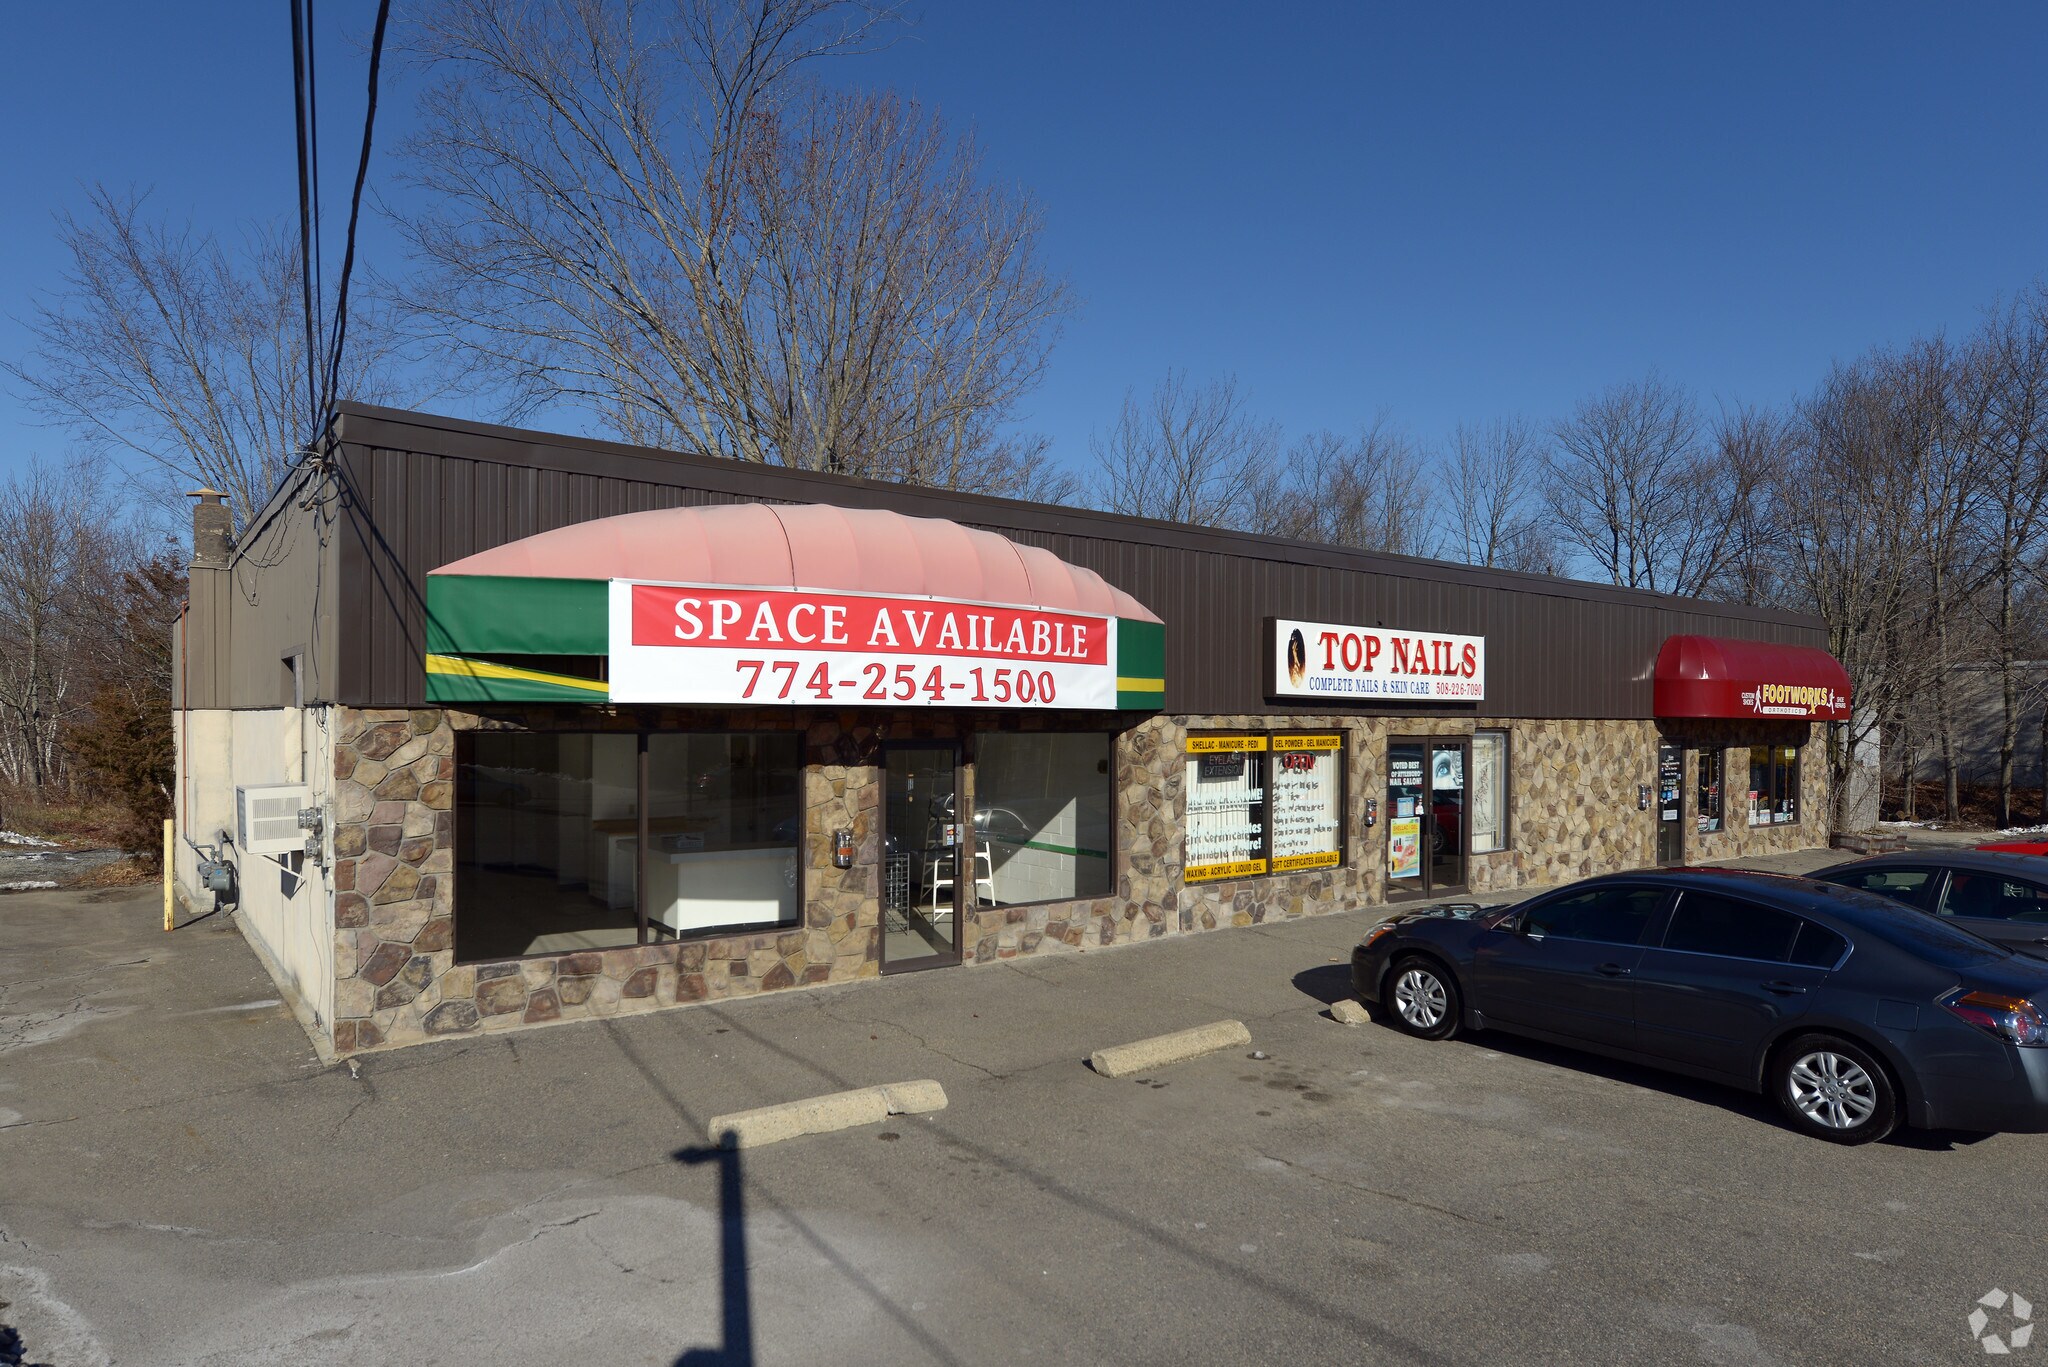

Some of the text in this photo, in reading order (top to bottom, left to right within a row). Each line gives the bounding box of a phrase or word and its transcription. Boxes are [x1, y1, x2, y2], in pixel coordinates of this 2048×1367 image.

[674, 598, 1088, 658] SPACE AVAILABLE
[1318, 631, 1477, 679] TOP NAILS
[735, 660, 1057, 704] 774-254-1500
[1309, 676, 1483, 696] COMPLETE NAILS & SKIN CARE 508-226-7090
[1762, 684, 1828, 714] FOOTWORKS
[1192, 740, 1215, 749] SHELLAC
[1218, 740, 1244, 749] MANICURE
[1247, 740, 1259, 748] PEDI
[1275, 738, 1284, 748] GEL
[1284, 738, 1303, 747] POWDER
[1306, 738, 1315, 747] GEL
[1316, 738, 1338, 747] MANICURE
[1209, 753, 1240, 765] EYELASH
[1284, 753, 1315, 770] OPEN
[1392, 761, 1420, 769] VOTED BEST
[1204, 764, 1242, 776] EXTENSION
[1389, 778, 1402, 786] NAIL
[1272, 859, 1283, 870] GIFT
[1283, 856, 1314, 867] CERTIFICATES
[1315, 854, 1338, 865] AVAILABLE
[1186, 868, 1207, 878] WAXING
[1210, 866, 1232, 875] ACRYLIC
[1235, 864, 1252, 873] LIQUID
[1252, 863, 1262, 871] GEL
